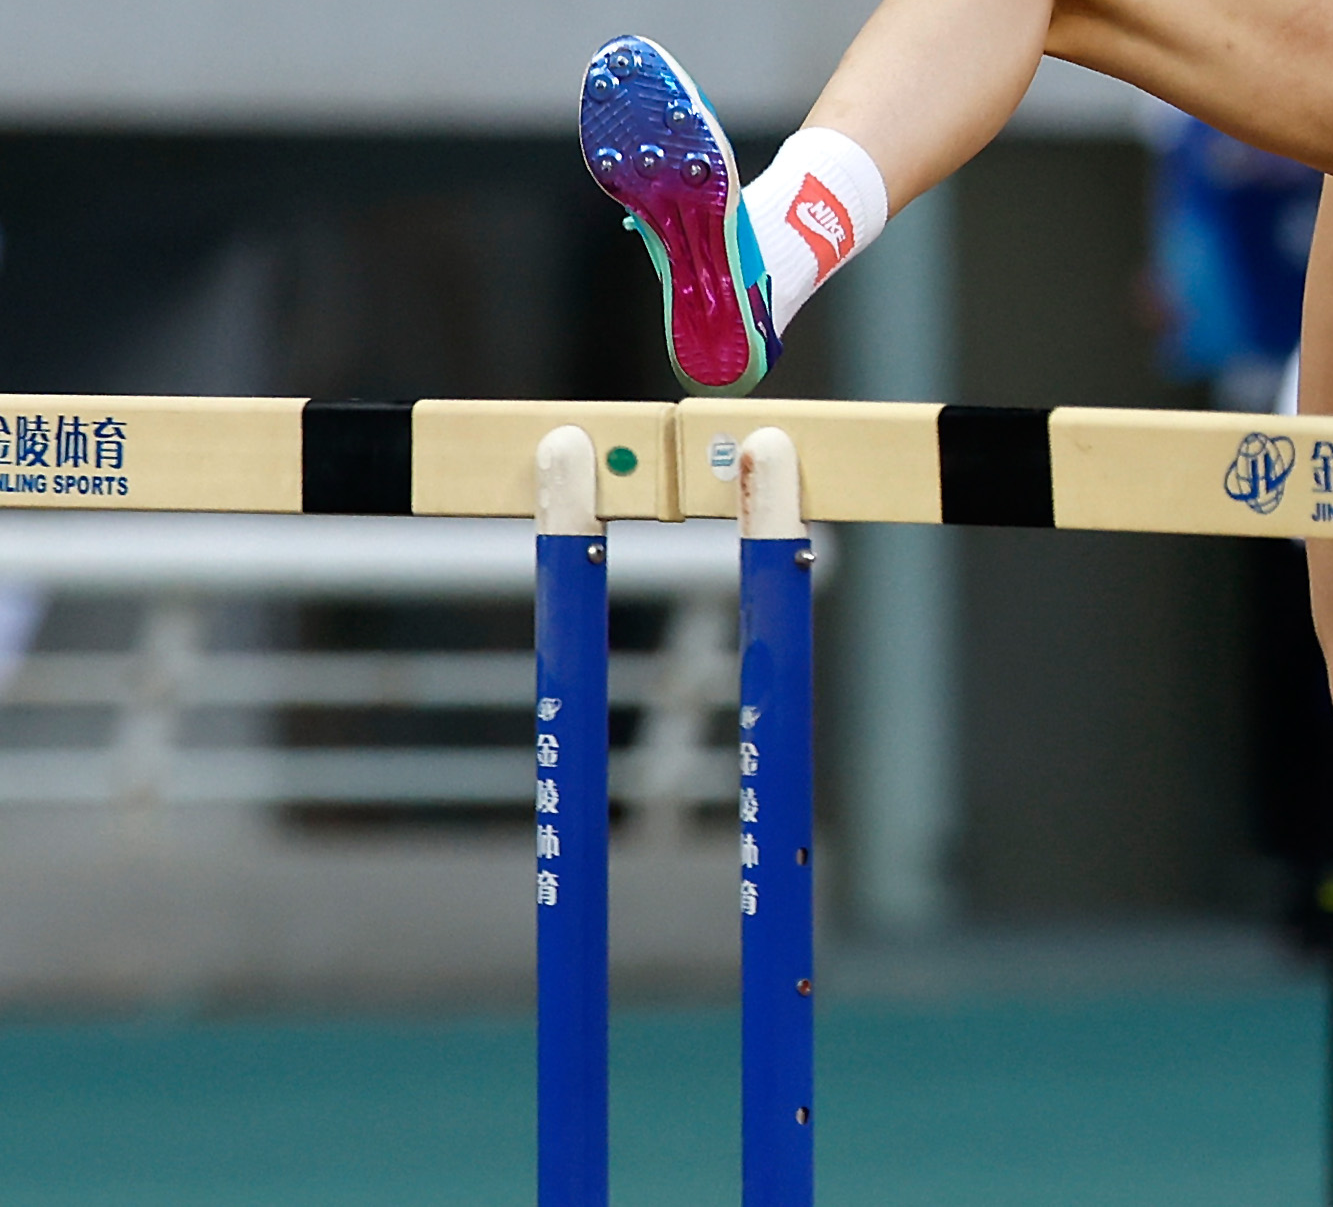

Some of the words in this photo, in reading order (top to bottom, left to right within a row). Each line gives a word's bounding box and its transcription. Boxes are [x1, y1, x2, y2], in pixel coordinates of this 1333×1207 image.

[811, 200, 846, 243] NIKE
[53, 475, 128, 495] SPORTS
[536, 734, 560, 906] 金陵体育
